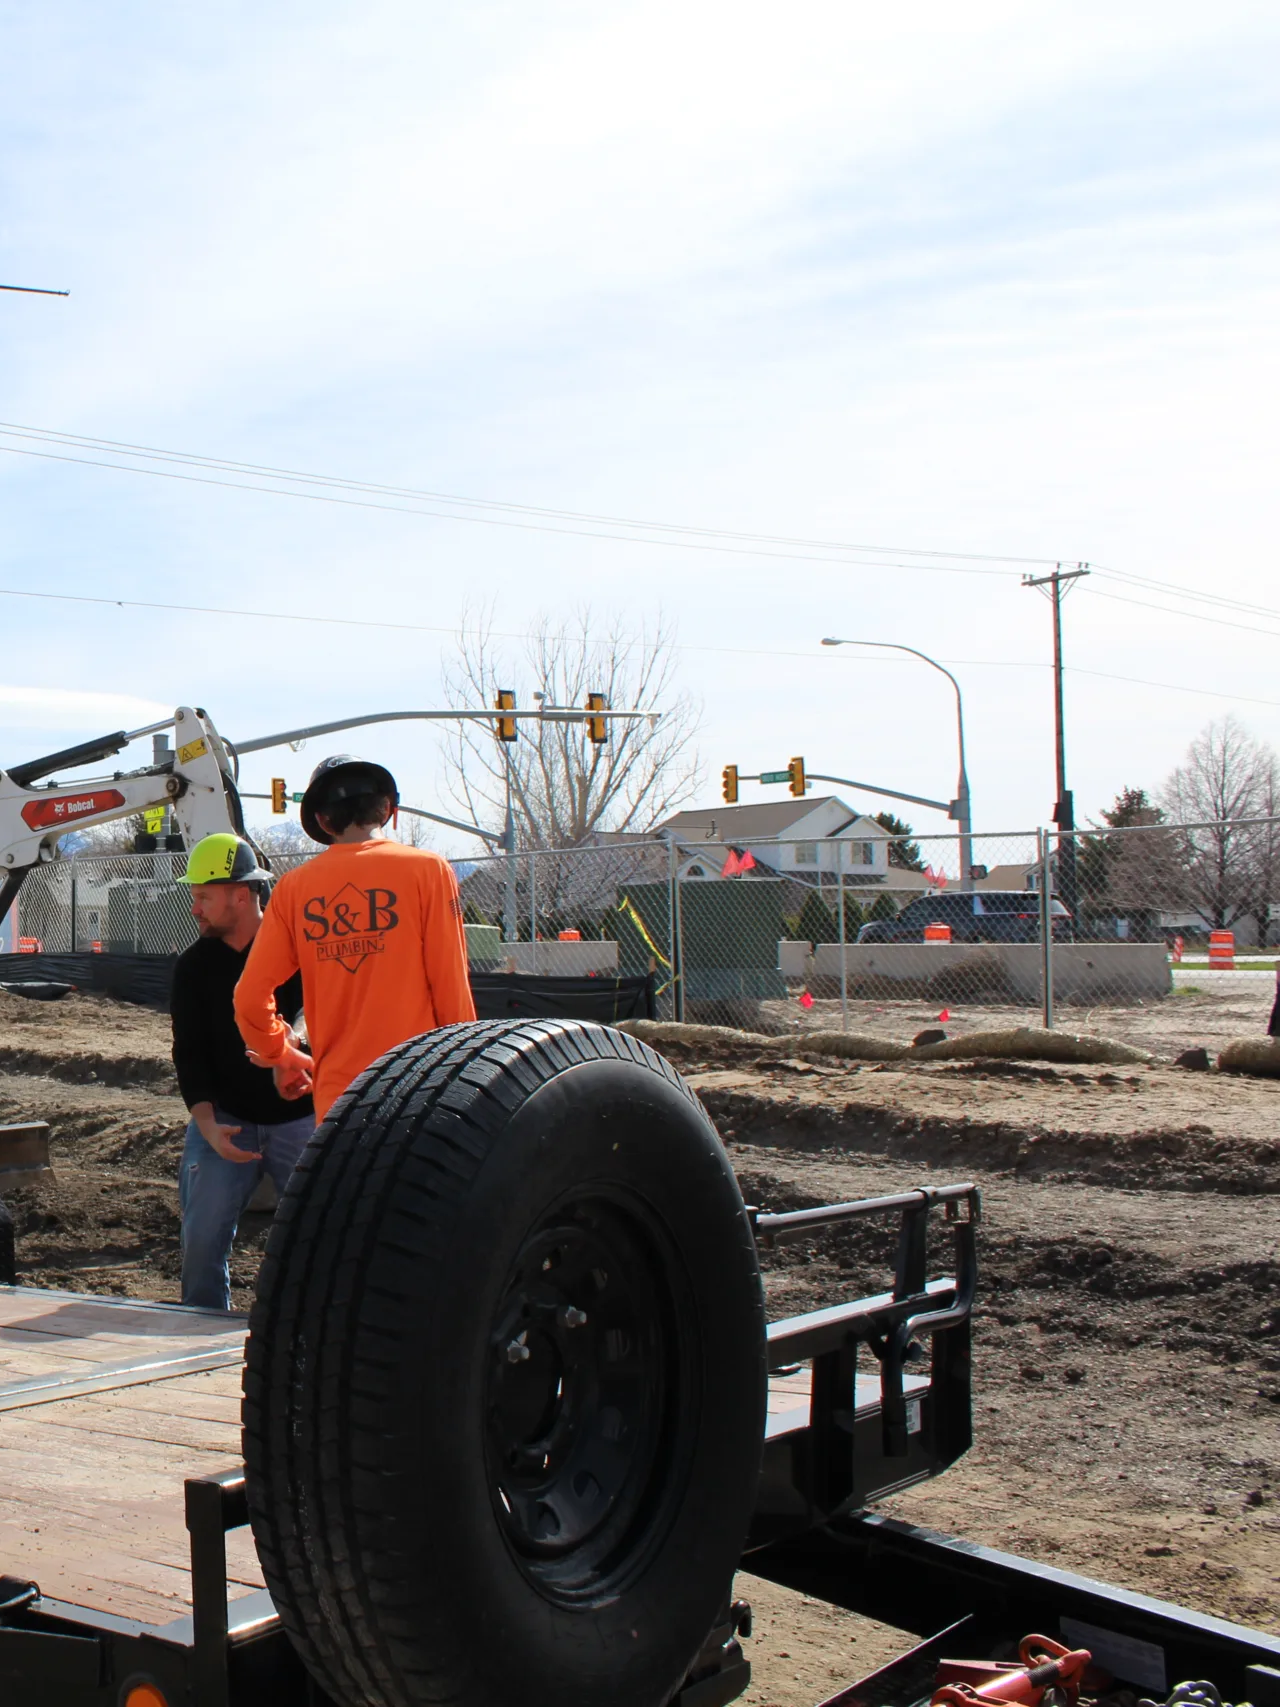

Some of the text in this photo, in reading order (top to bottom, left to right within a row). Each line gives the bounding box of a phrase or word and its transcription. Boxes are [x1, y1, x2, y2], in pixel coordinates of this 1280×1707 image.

[67, 798, 95, 814] Bobcat
[224, 848, 235, 872] LIFT
[303, 888, 399, 942] S&B
